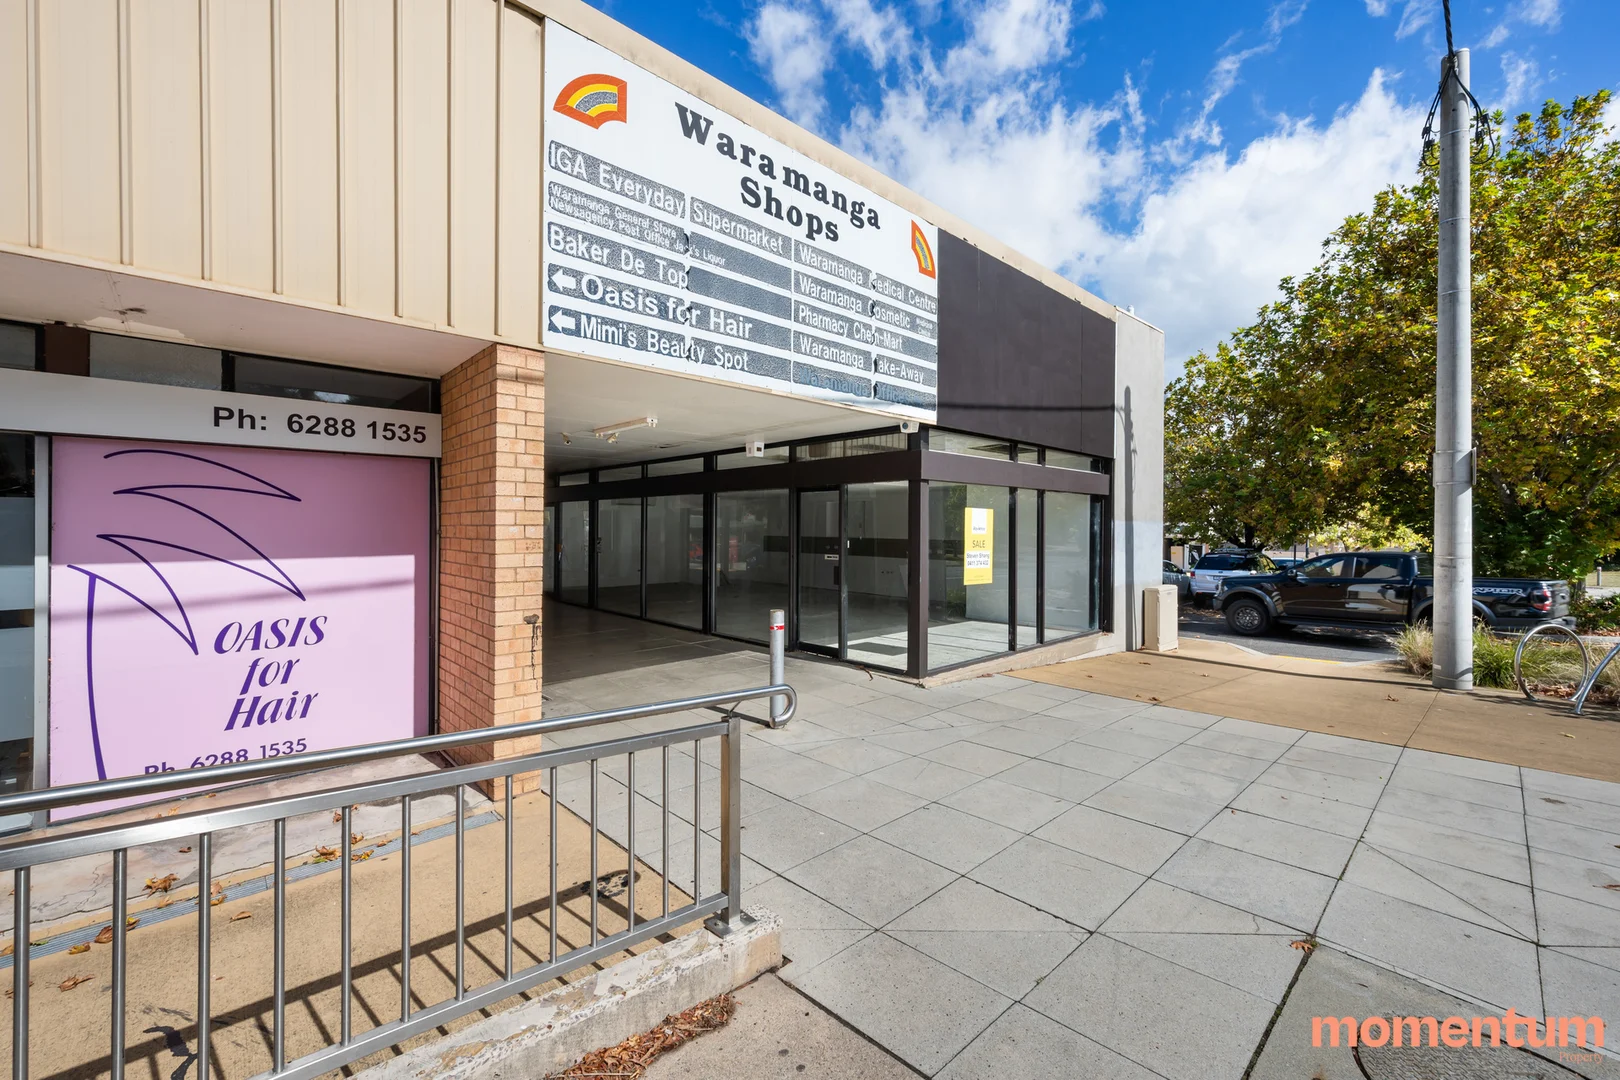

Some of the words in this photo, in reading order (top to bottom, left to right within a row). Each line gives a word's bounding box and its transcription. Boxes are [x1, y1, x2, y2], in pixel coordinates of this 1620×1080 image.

[675, 101, 881, 230] Waramanga
[550, 142, 589, 181] IGA
[599, 160, 686, 219] Everyday
[693, 200, 784, 255] Supermarket
[550, 183, 610, 215] Waramanga
[614, 206, 650, 228] General
[653, 220, 677, 238] Store
[740, 176, 839, 242] Shops
[550, 196, 614, 229] Newsagency
[619, 221, 640, 236] Post
[644, 229, 670, 248] Office
[702, 248, 726, 266] Liquor
[550, 224, 611, 265] Baker
[620, 248, 646, 275] De
[654, 258, 689, 290] Top
[581, 273, 659, 316] Oasis
[666, 296, 701, 326] for
[709, 307, 753, 339] Hair
[799, 244, 863, 284] Waramanga
[908, 288, 936, 313] Centre
[799, 274, 862, 312] Waramanga
[867, 299, 911, 329] Cosmetic
[580, 314, 638, 348] Mimi's
[647, 329, 705, 365] Beauty
[714, 344, 749, 371] Spot
[799, 304, 849, 340] Pharmacy
[800, 334, 864, 369] Waramanga
[213, 406, 267, 431] Ph:
[287, 413, 356, 438] 6288
[366, 420, 427, 444] 1535
[213, 615, 328, 655] OASIS
[239, 657, 300, 696] for
[223, 690, 319, 731] Hair
[190, 748, 249, 769] 6288
[260, 737, 307, 760] 1535
